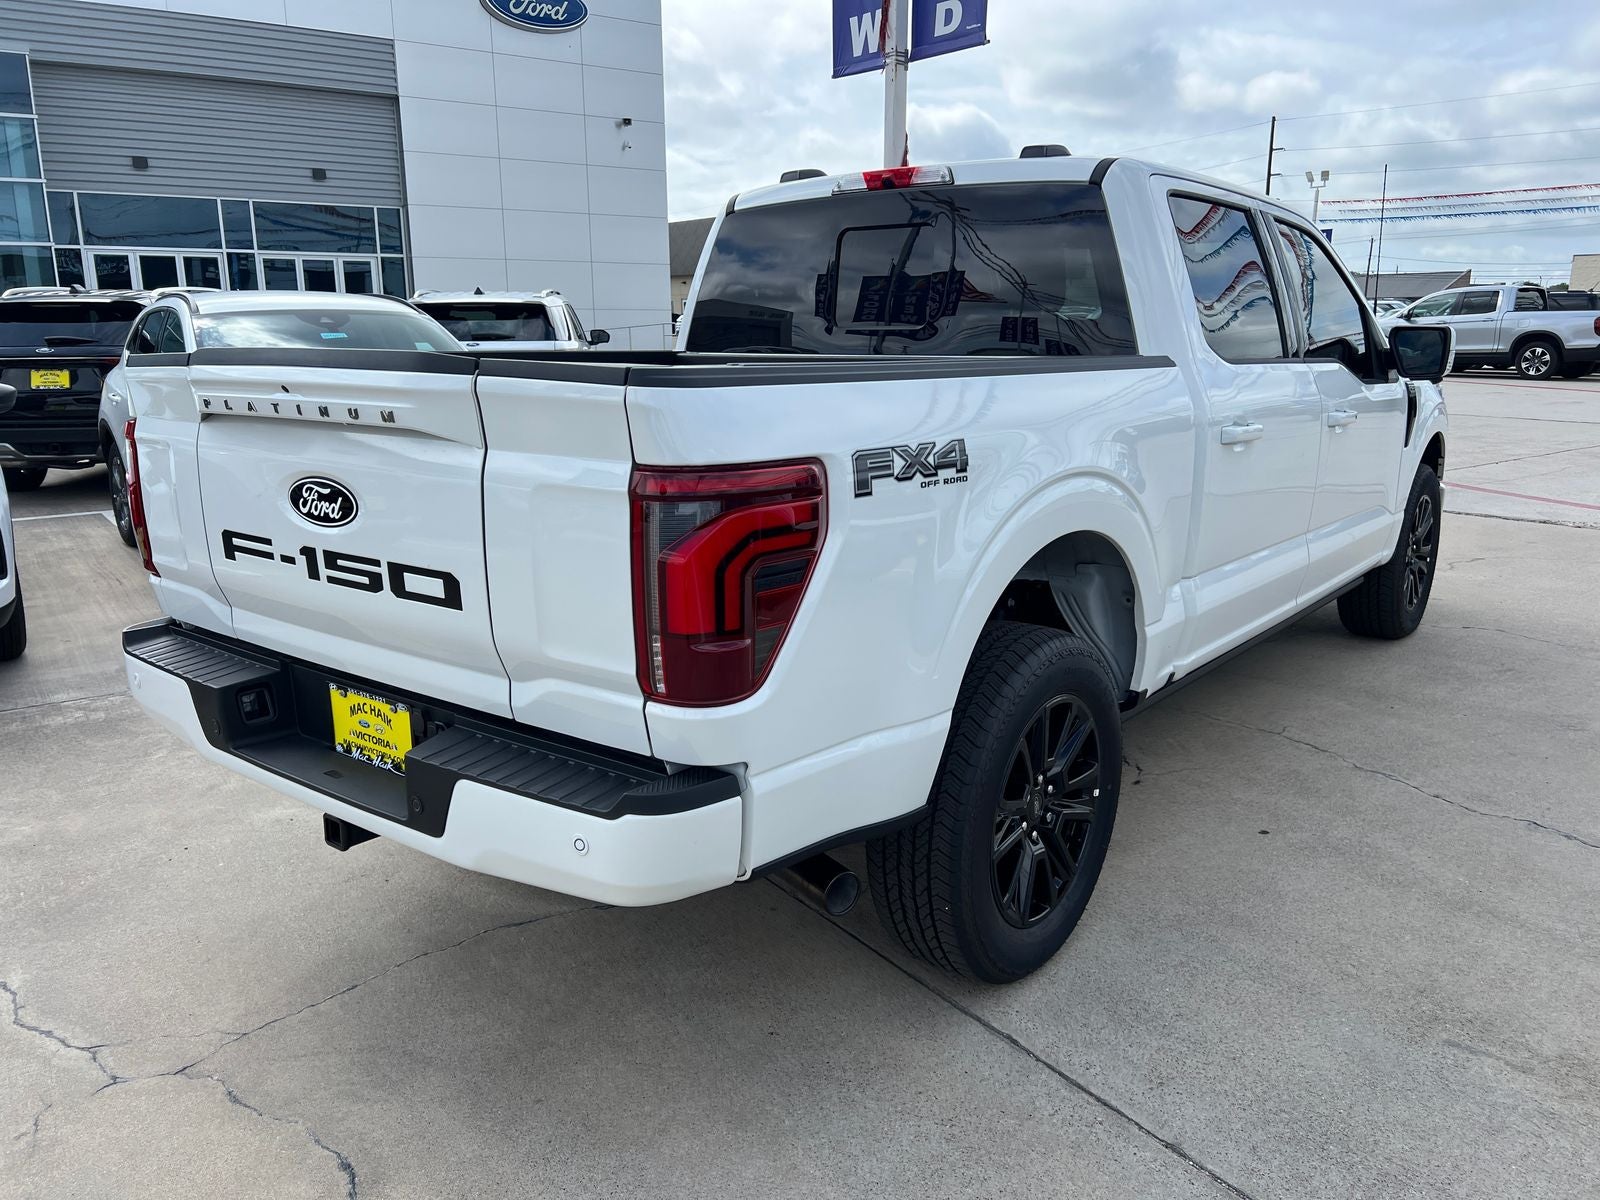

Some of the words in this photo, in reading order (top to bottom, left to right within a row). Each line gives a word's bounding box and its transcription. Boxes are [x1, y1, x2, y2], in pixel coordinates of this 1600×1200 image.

[849, 8, 883, 58] W
[934, 0, 963, 38] D
[202, 398, 396, 424] PLATINUM
[851, 438, 969, 498] FX4
[920, 479, 940, 489] OFF
[943, 475, 968, 486] ROAD
[299, 483, 343, 520] Ford
[221, 529, 463, 612] F-150
[349, 702, 368, 717] MAC
[369, 703, 393, 730] HAIK
[351, 747, 371, 763] Mac
[354, 731, 392, 749] VICTORIA
